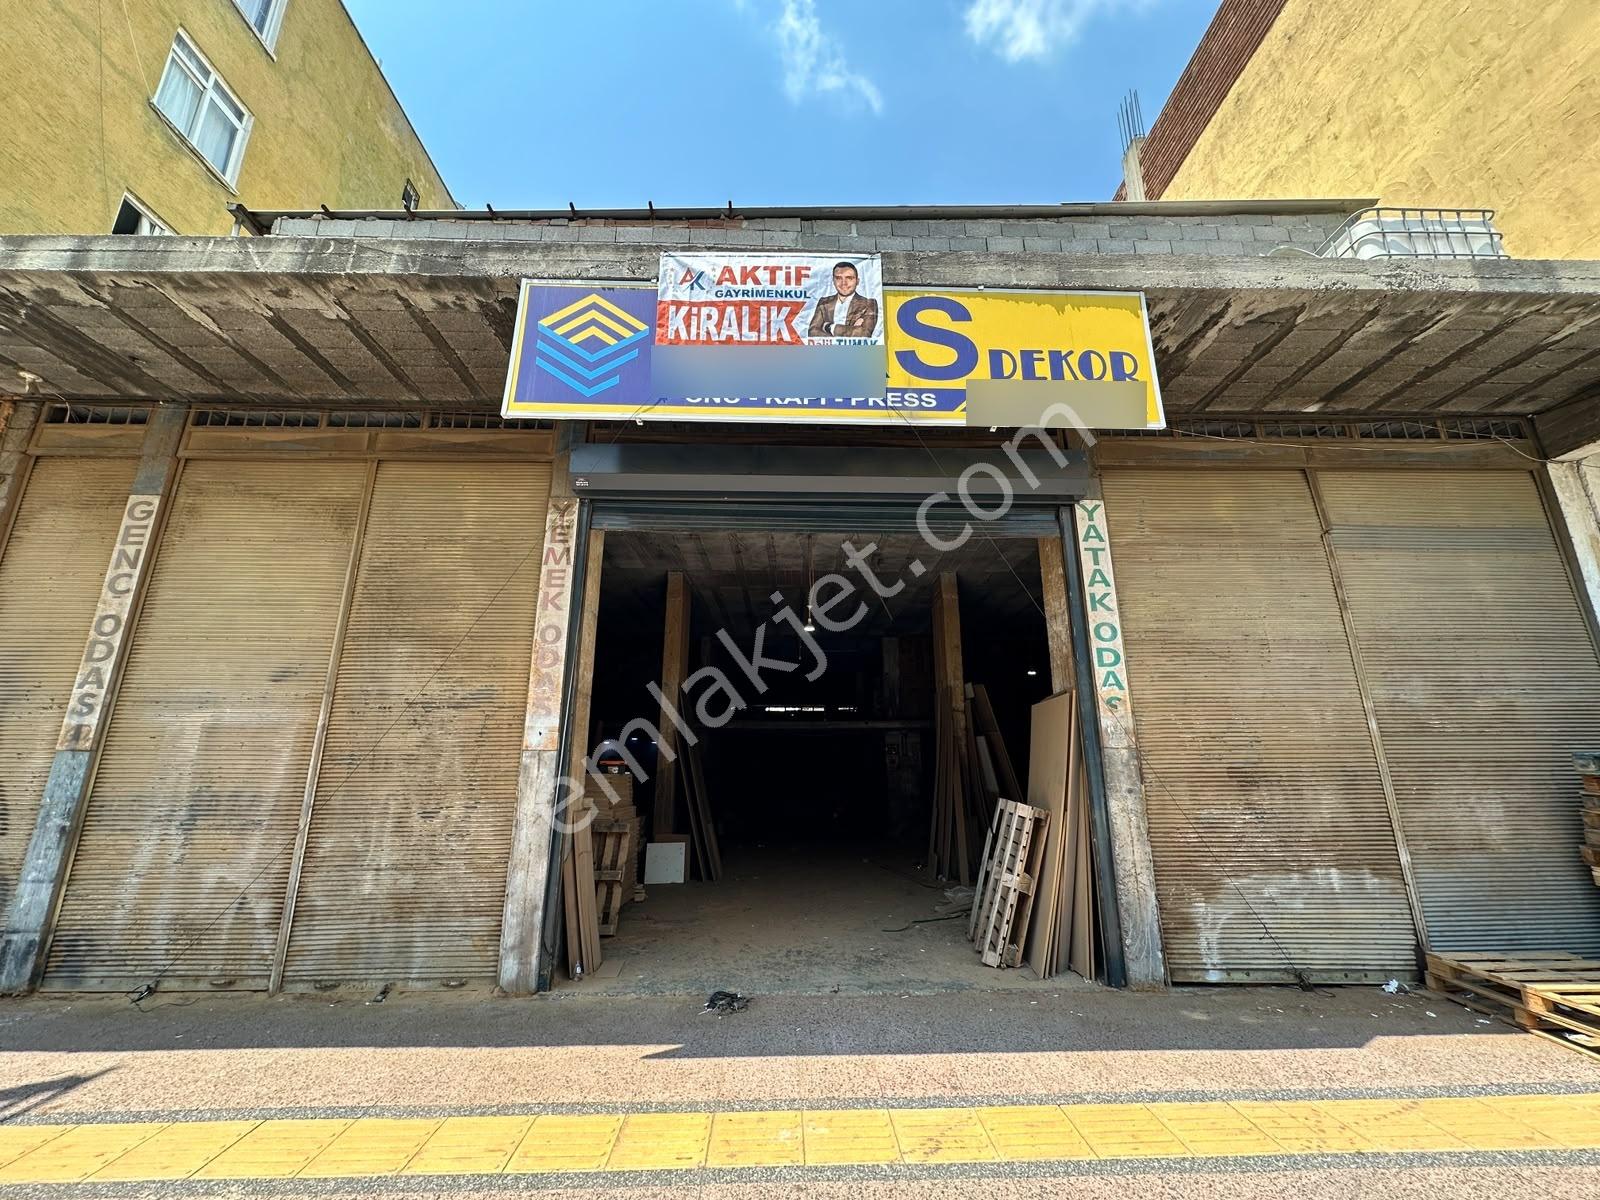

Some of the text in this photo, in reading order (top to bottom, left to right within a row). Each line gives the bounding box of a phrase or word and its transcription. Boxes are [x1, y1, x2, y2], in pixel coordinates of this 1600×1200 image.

[715, 287, 811, 299] GAYRİMENKUL
[987, 349, 1139, 381] DEKOR
[539, 503, 574, 611] YEMEK
[1077, 503, 1114, 612] YATAK
